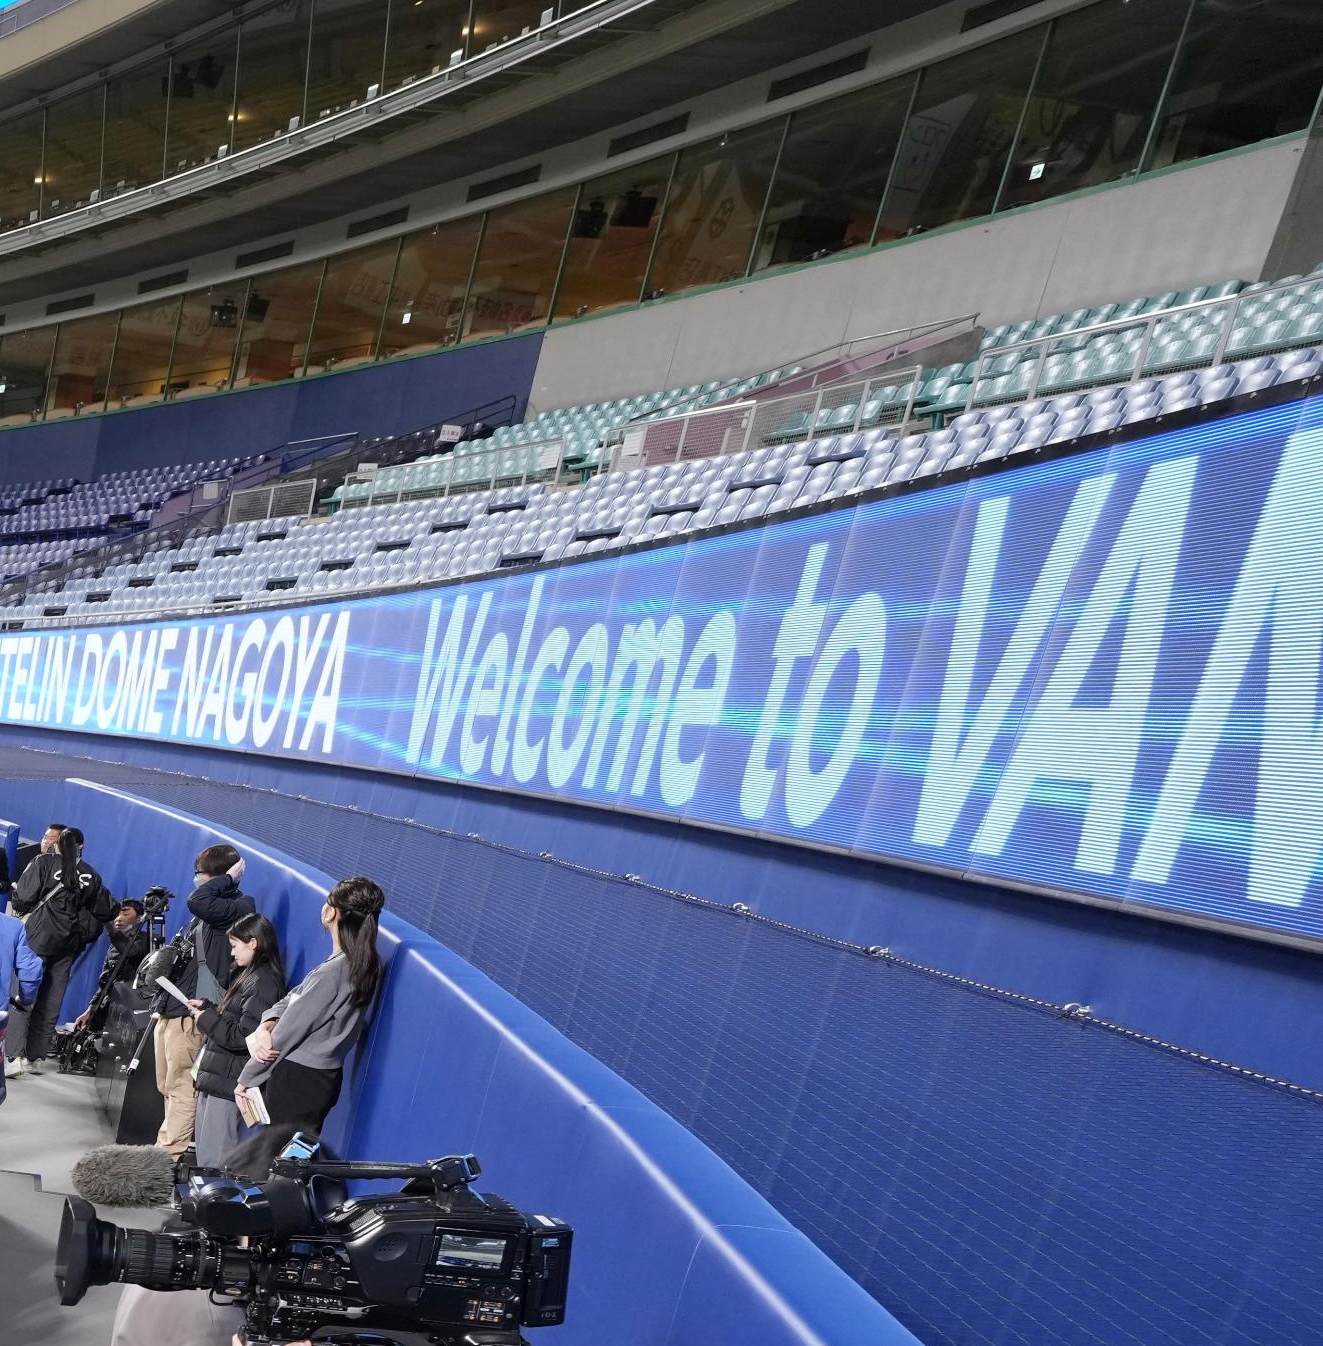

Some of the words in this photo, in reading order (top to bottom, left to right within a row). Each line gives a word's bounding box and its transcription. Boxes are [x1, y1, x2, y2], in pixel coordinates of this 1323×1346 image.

[72, 626, 179, 735] DOME
[178, 610, 353, 754] NAGOYA
[405, 576, 738, 806] Welcome
[739, 543, 888, 829] to
